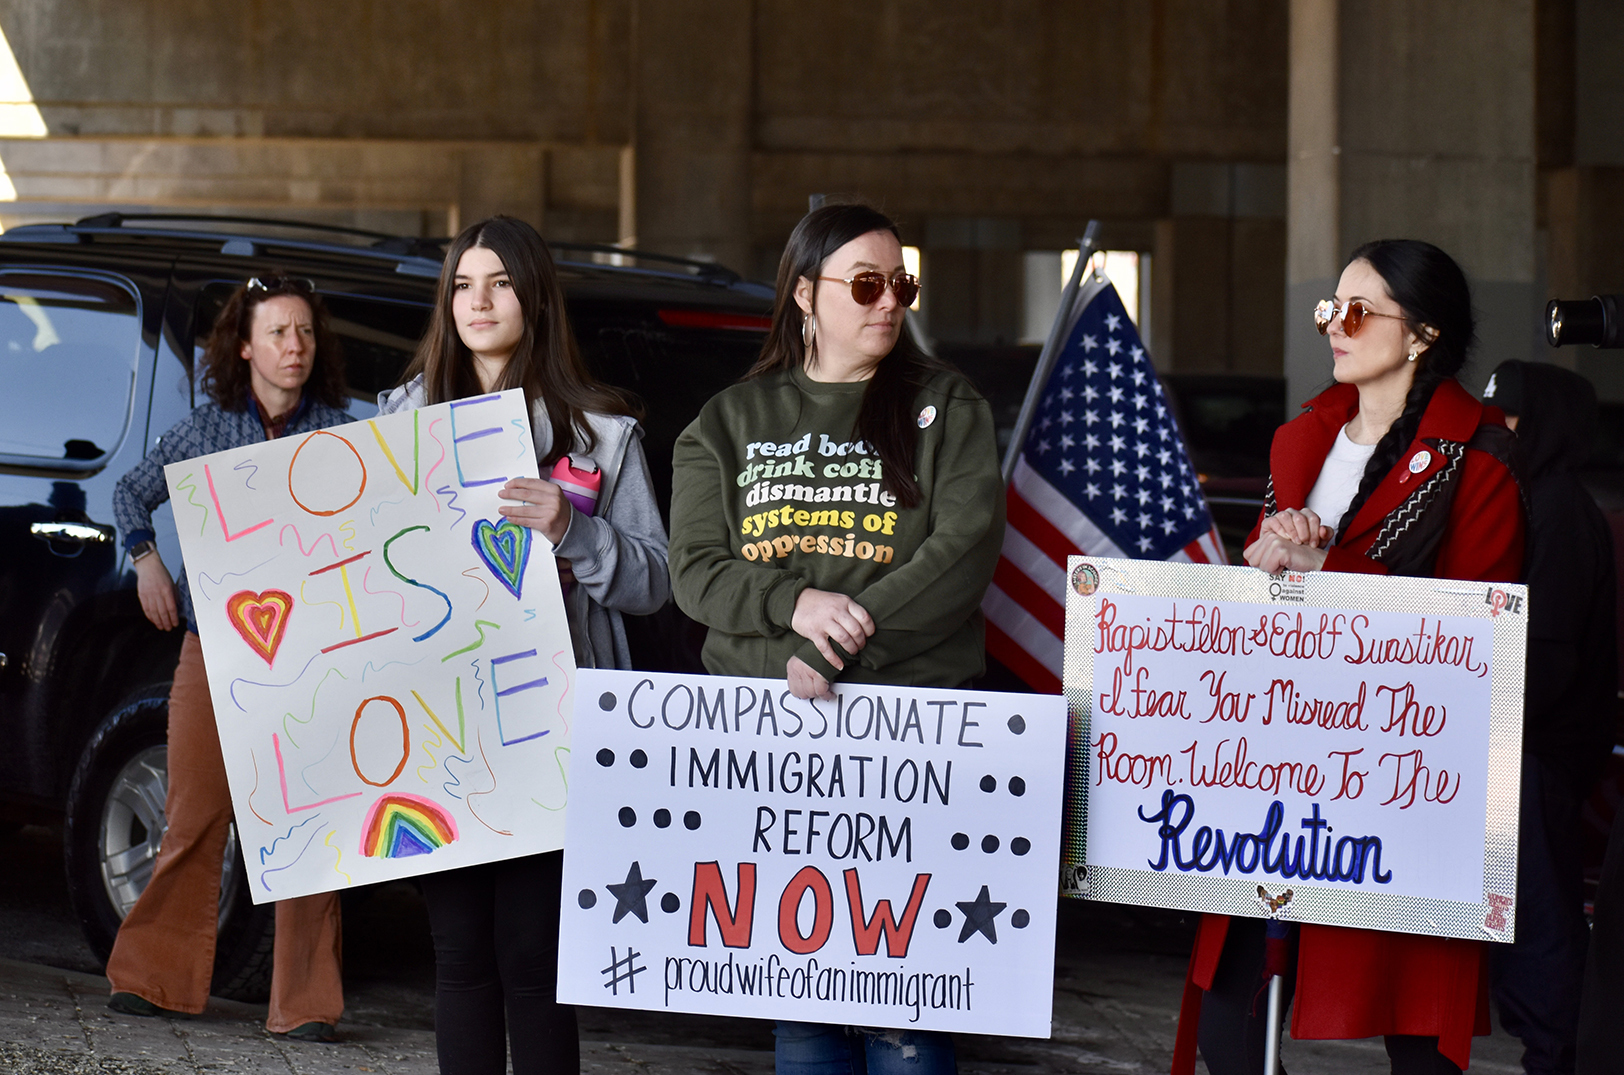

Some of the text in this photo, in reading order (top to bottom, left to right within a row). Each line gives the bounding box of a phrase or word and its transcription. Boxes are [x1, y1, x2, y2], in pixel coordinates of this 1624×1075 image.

[205, 395, 508, 542] LOVE
[736, 455, 918, 488] drink coff
[745, 432, 880, 460] read boo
[741, 504, 898, 537] systems of
[745, 481, 897, 508] dismantle
[741, 533, 894, 564] oppression
[1289, 575, 1305, 583] NO!
[309, 525, 452, 654] IS
[1485, 587, 1523, 617] LOVE
[1094, 598, 1183, 676] Rapist
[1269, 612, 1346, 660] Edolf
[272, 649, 550, 814] LOVE
[628, 678, 987, 748] COMPASSIONATE
[1199, 670, 1256, 723] You
[1262, 679, 1369, 732] Misread
[1376, 681, 1446, 737] The
[670, 746, 952, 806] IMMIGRATION
[1091, 732, 1461, 810] Room. Welcome To The
[753, 806, 912, 863] REFORM
[1138, 789, 1392, 885] Revolution
[687, 860, 932, 959] NOW
